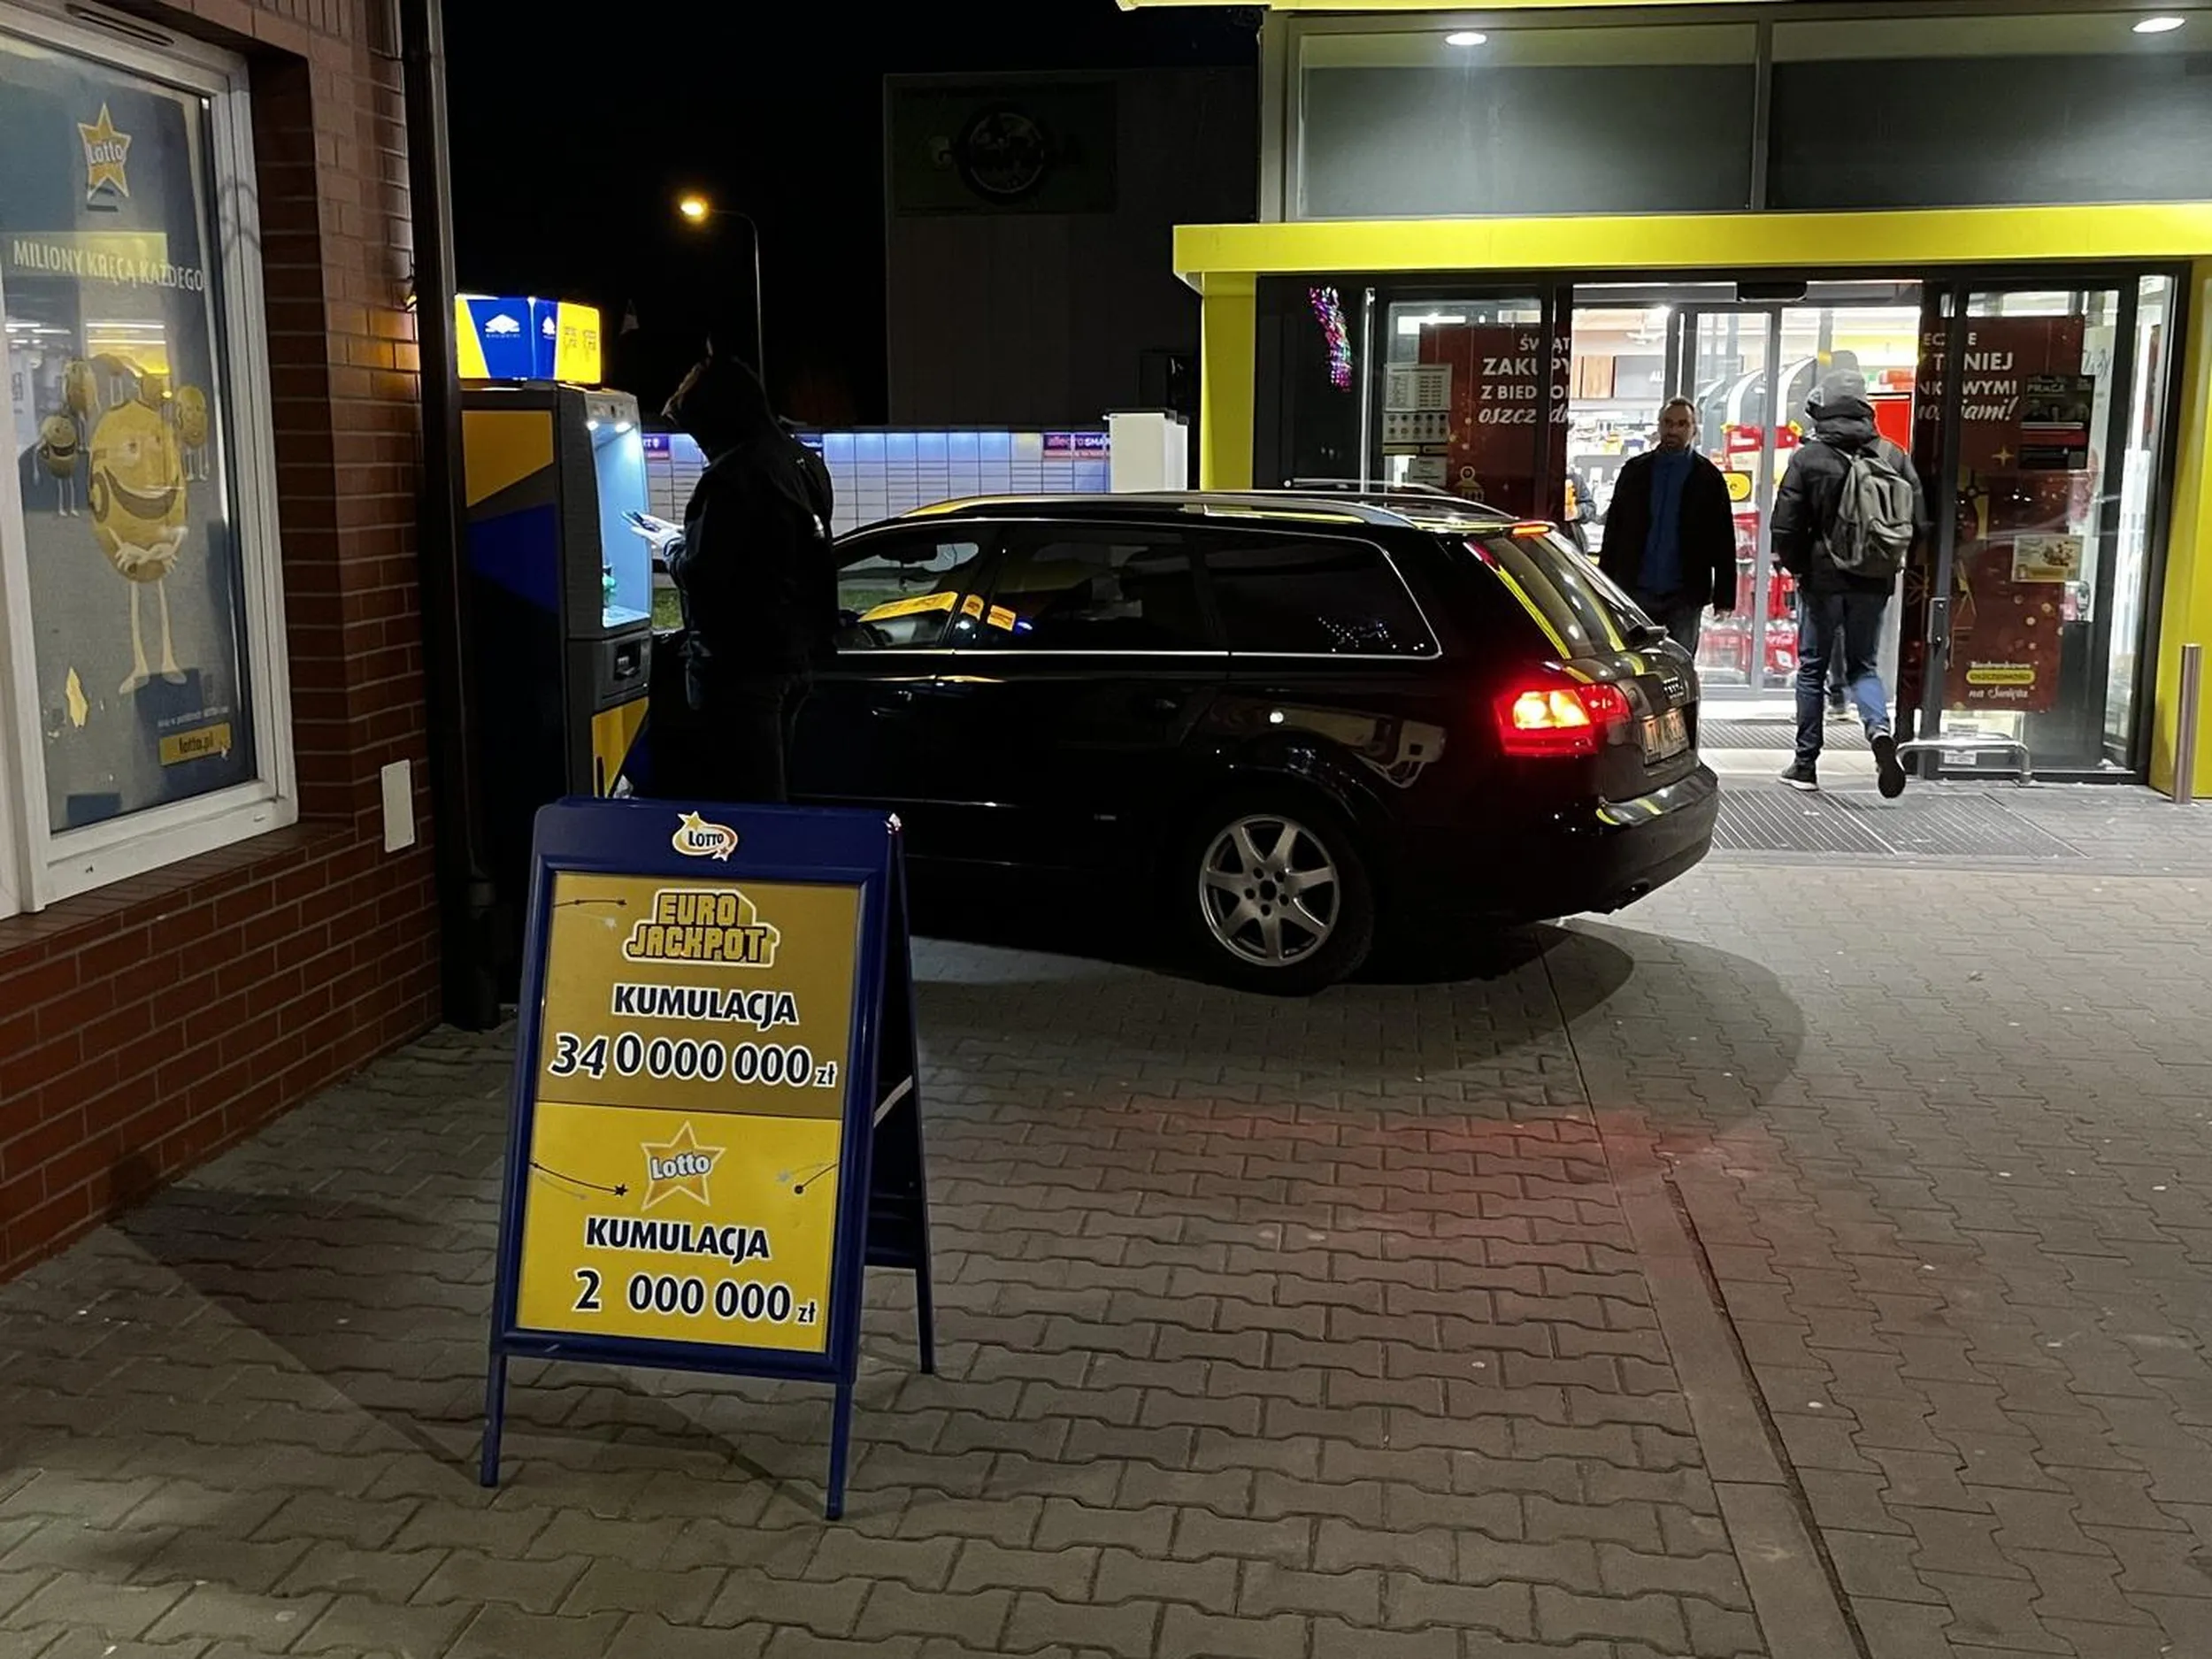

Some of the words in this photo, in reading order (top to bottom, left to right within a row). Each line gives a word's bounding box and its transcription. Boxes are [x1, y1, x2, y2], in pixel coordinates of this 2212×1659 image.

[86, 139, 125, 165] Lotto
[13, 240, 83, 274] MILIONY
[1480, 385, 1493, 400] Z
[687, 830, 725, 848] LOTTO
[657, 893, 740, 927] EURO
[626, 924, 768, 963] JACKPOT
[613, 984, 797, 1030] KUMULACJA
[817, 1063, 835, 1087] zł
[650, 1152, 711, 1180] Lotto
[586, 1217, 770, 1265] KUMULACJA
[574, 1269, 601, 1310] 2
[628, 1274, 705, 1316] 000
[714, 1280, 791, 1322] 000
[797, 1301, 816, 1325] zł
